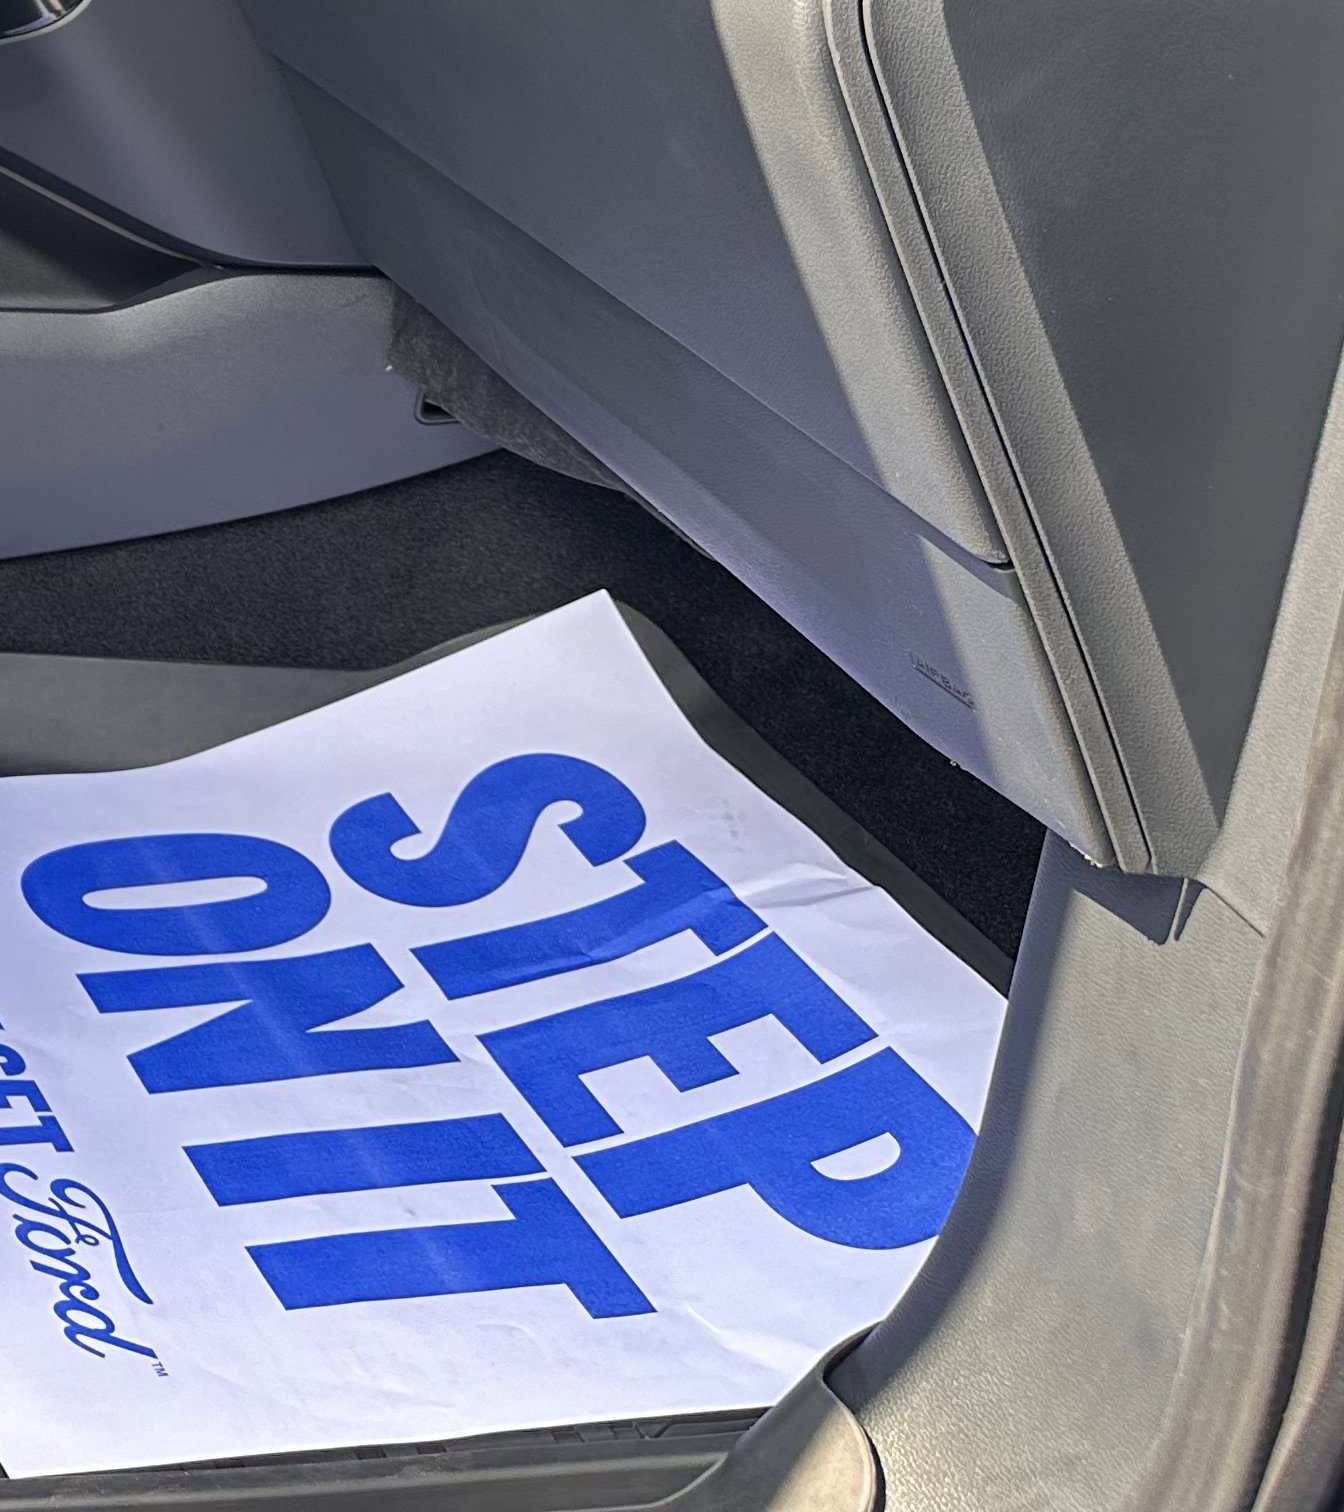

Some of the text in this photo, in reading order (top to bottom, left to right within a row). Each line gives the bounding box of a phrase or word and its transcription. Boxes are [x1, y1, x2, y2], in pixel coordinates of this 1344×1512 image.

[19, 832, 655, 1319] ON IT
[328, 752, 979, 1250] STEP
